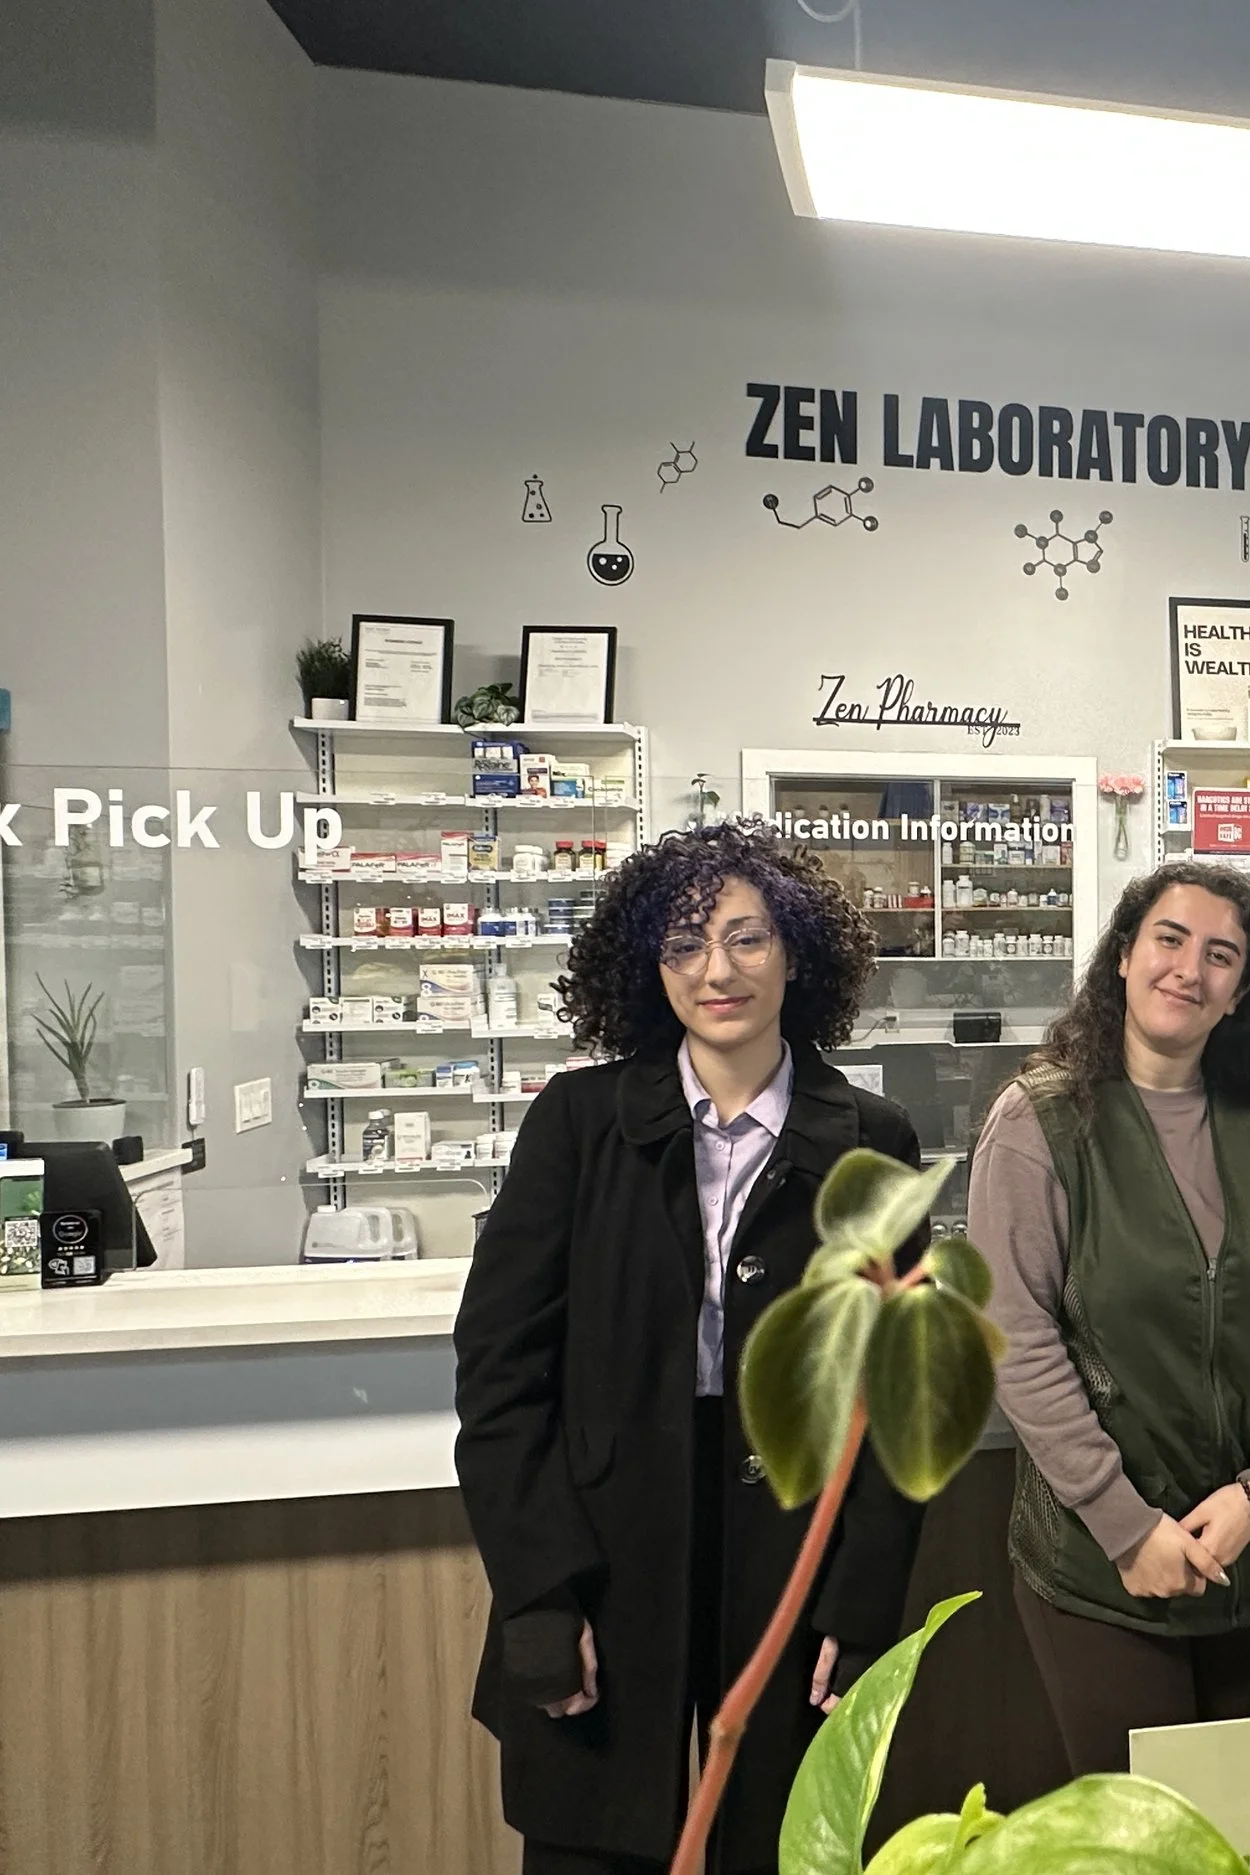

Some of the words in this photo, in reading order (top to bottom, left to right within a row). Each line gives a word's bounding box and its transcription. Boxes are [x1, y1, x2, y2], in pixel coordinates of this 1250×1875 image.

[746, 382, 858, 465] ZEN
[1184, 642, 1202, 657] IS
[813, 674, 869, 728] Zen
[876, 673, 1009, 748] Pharmacy
[53, 787, 220, 849] Pick
[246, 791, 343, 865] Up
[901, 813, 1074, 842] Information
